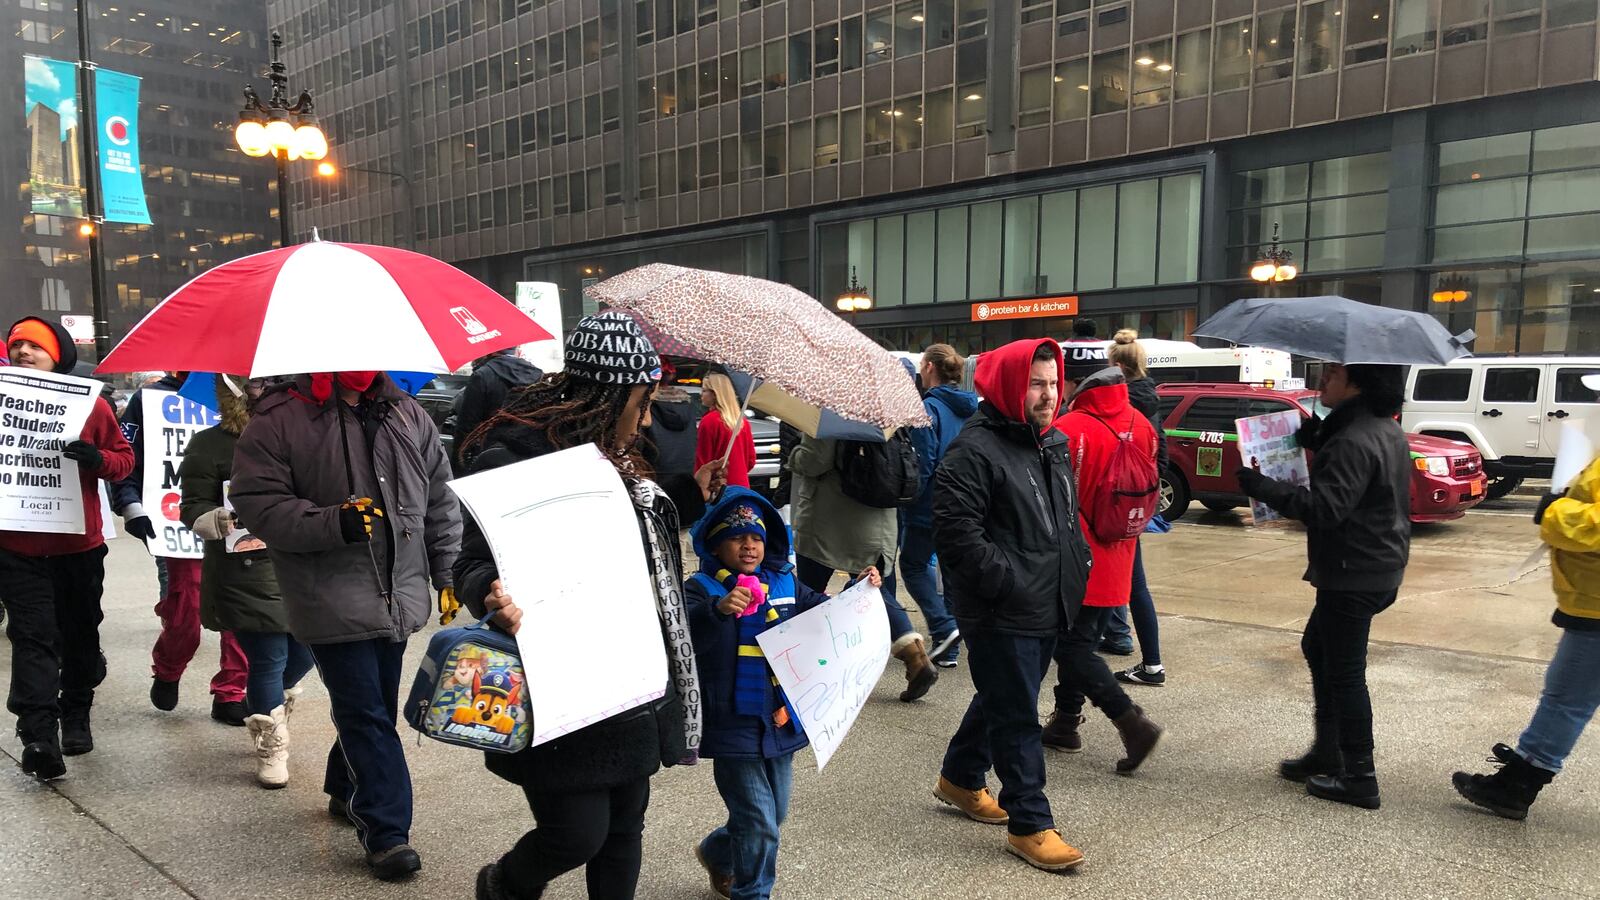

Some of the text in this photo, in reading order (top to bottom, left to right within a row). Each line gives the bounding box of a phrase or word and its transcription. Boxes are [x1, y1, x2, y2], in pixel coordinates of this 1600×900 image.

[990, 302, 1069, 316] protein bar & kitchen
[570, 331, 646, 354] OBAMA
[565, 350, 627, 367] OBAMA
[1145, 356, 1177, 366] go.com
[40, 380, 68, 391] STUDENTS
[0, 393, 67, 416] Teachers
[2, 413, 65, 434] Students
[1199, 431, 1225, 443] 4703
[16, 471, 62, 488] Much!
[20, 500, 61, 511] Local 1
